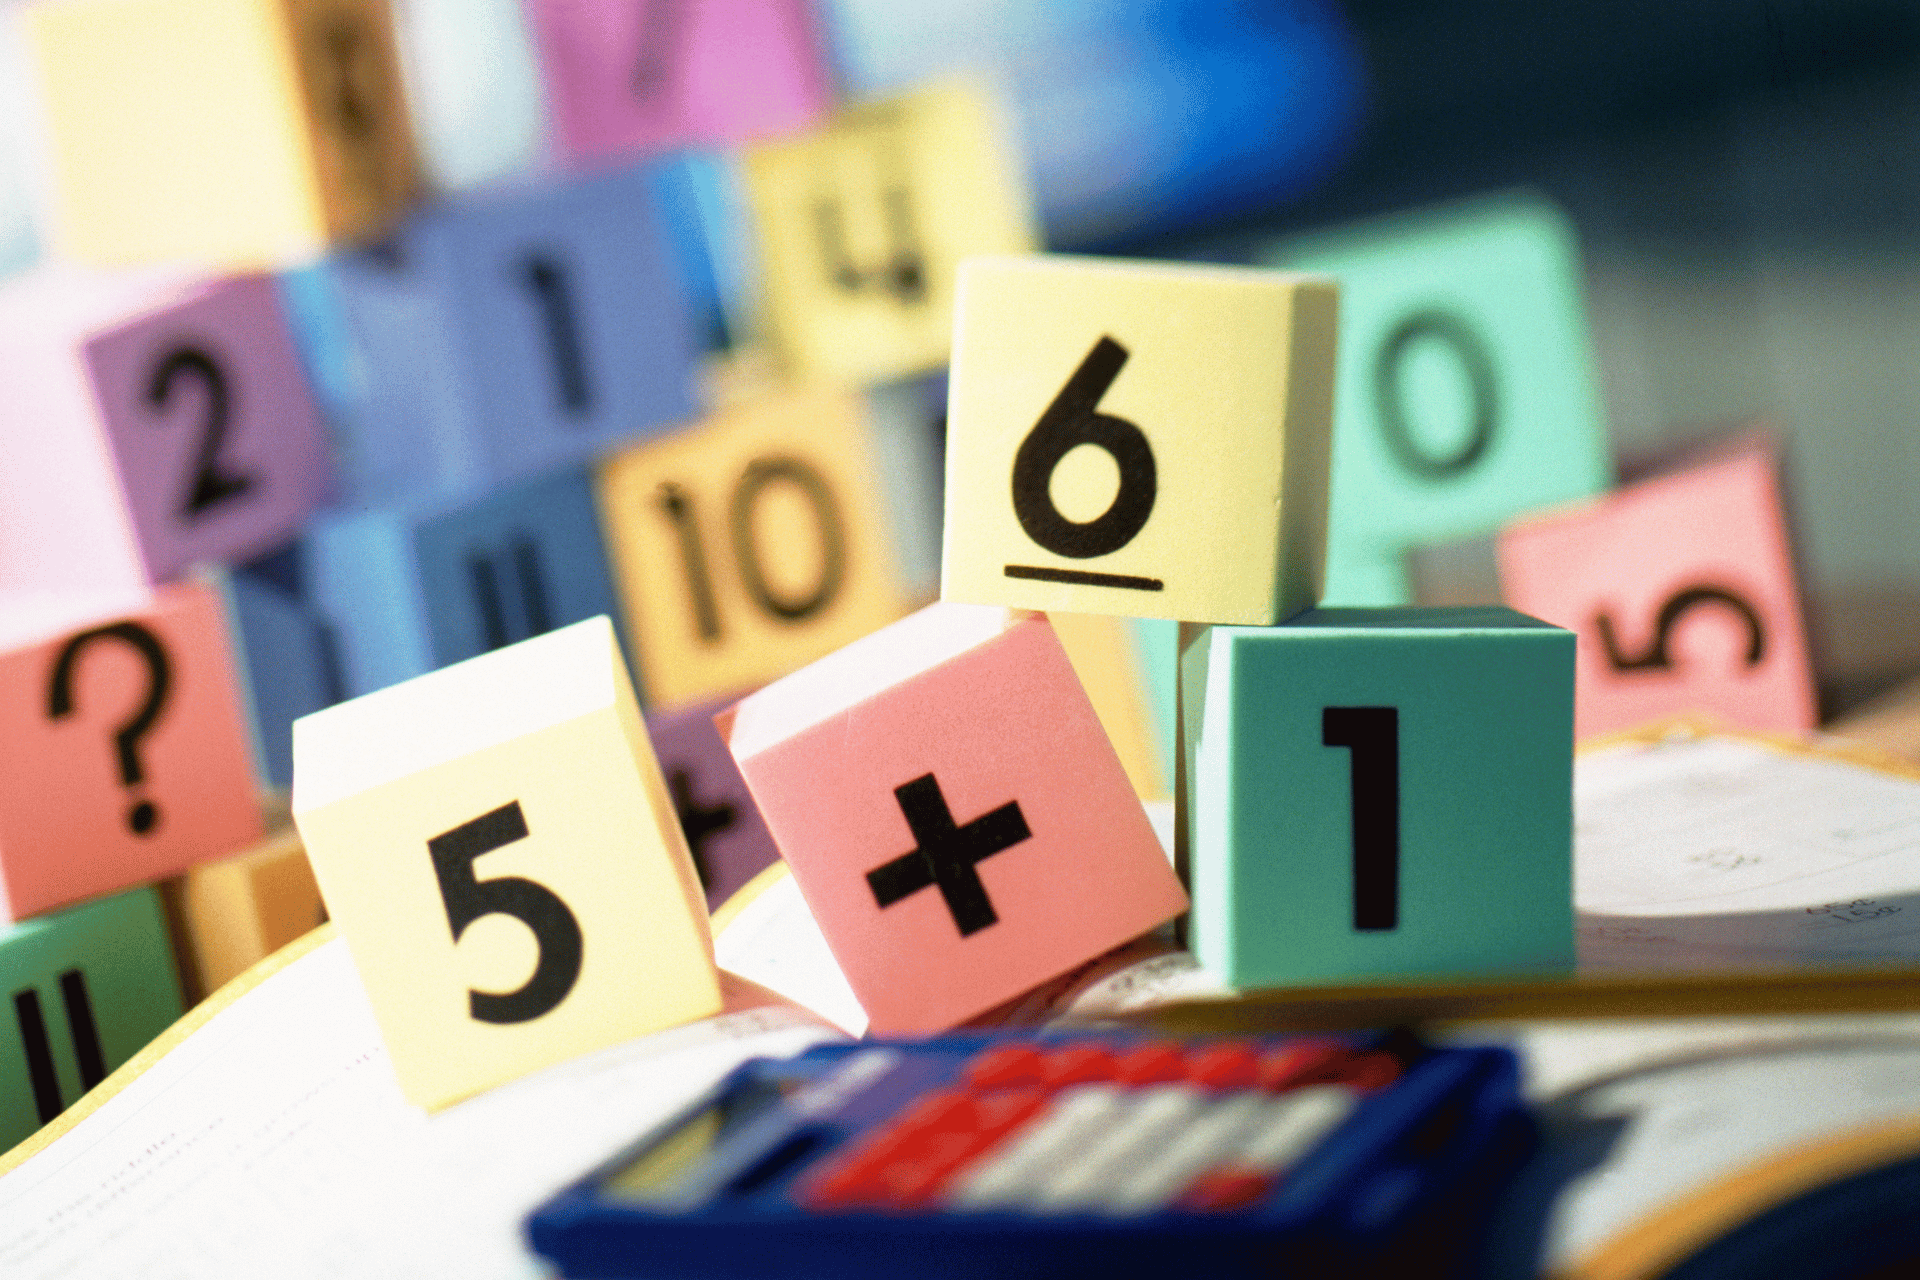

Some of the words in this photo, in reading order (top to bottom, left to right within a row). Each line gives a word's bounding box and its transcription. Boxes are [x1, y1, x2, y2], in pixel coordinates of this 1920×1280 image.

[517, 246, 594, 419] 1
[142, 342, 263, 528] 2
[1012, 333, 1157, 559] 6
[655, 454, 848, 643] 10
[1593, 583, 1766, 676] 5
[44, 620, 175, 838] ?
[1322, 706, 1400, 932] 1
[426, 799, 585, 1026] 5
[865, 772, 1033, 939] +
